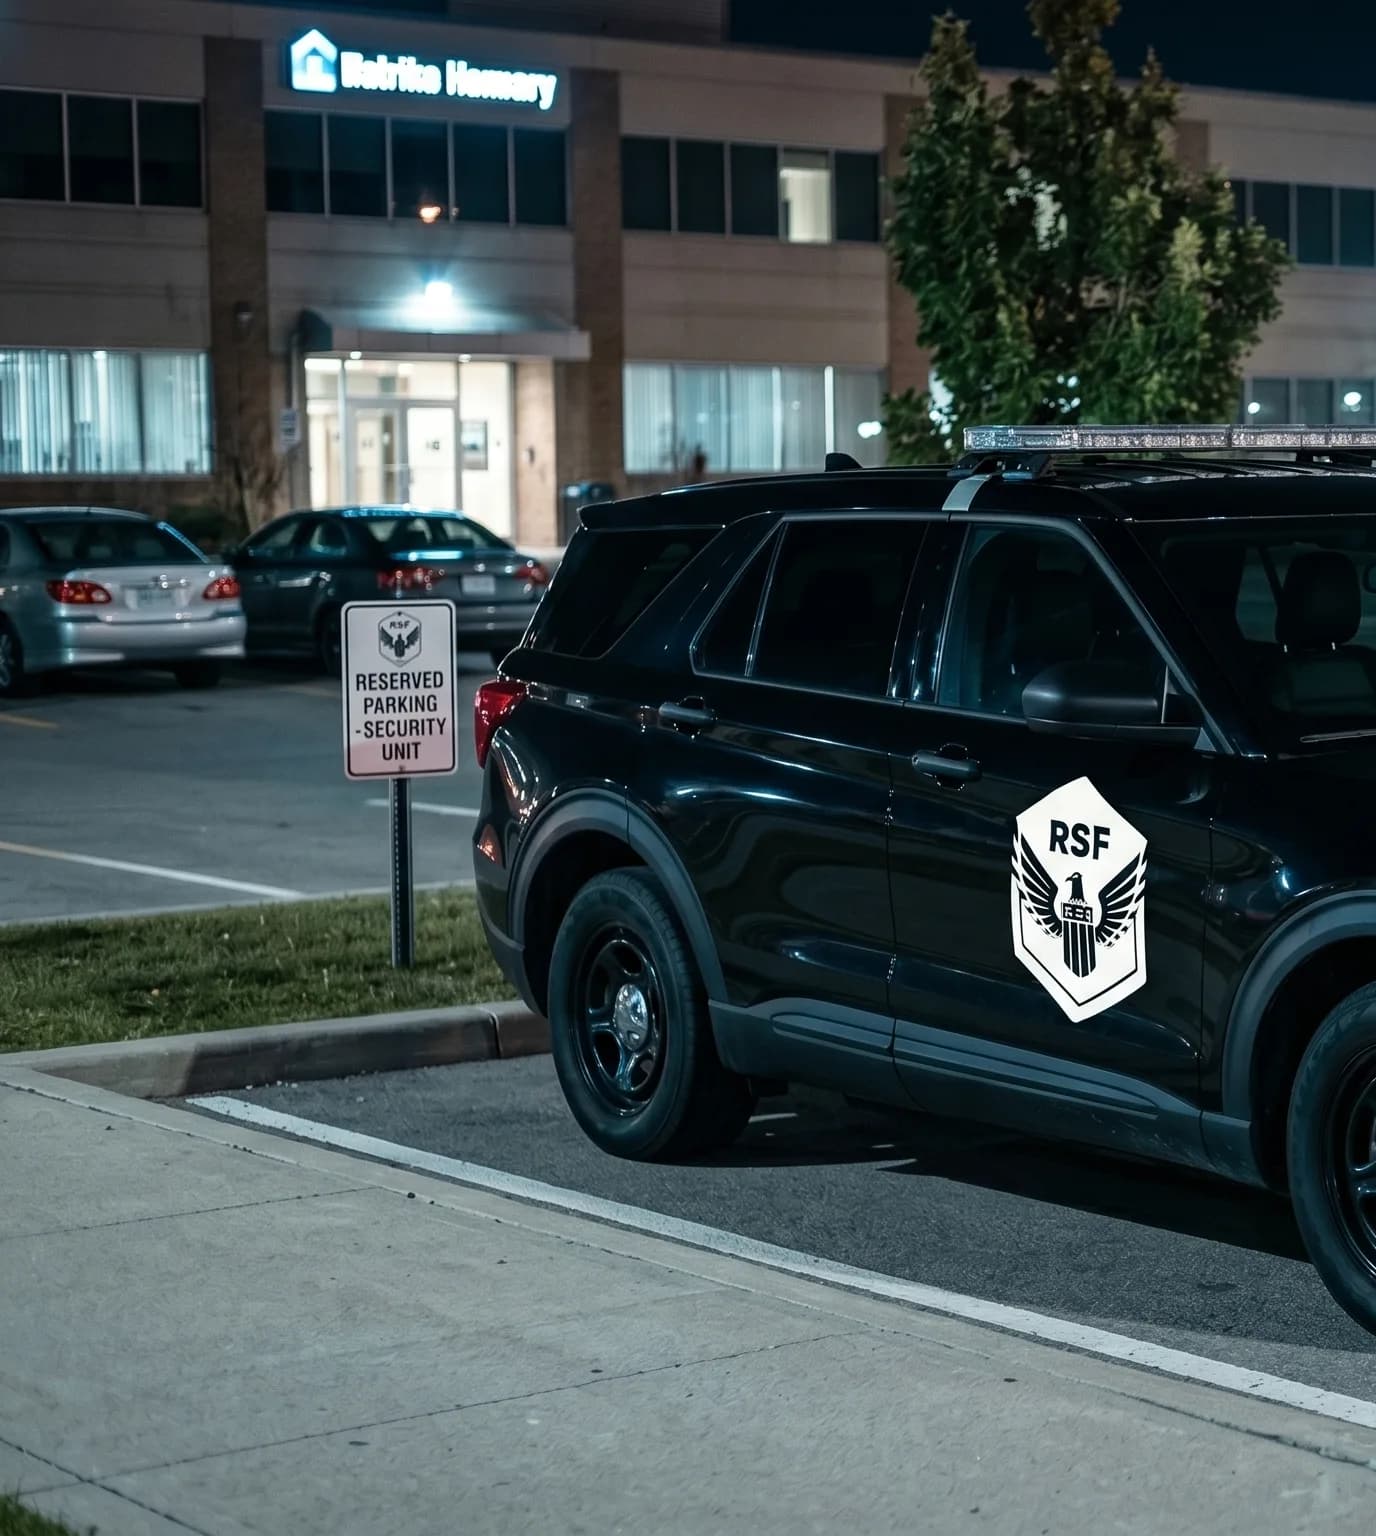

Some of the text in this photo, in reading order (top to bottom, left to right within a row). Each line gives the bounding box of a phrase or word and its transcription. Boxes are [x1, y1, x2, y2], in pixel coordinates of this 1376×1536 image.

[389, 620, 411, 630] RSF
[355, 671, 444, 691] RESERVED
[363, 694, 438, 715] PARKING
[382, 741, 421, 761] UNIT
[1049, 819, 1111, 860] RSF
